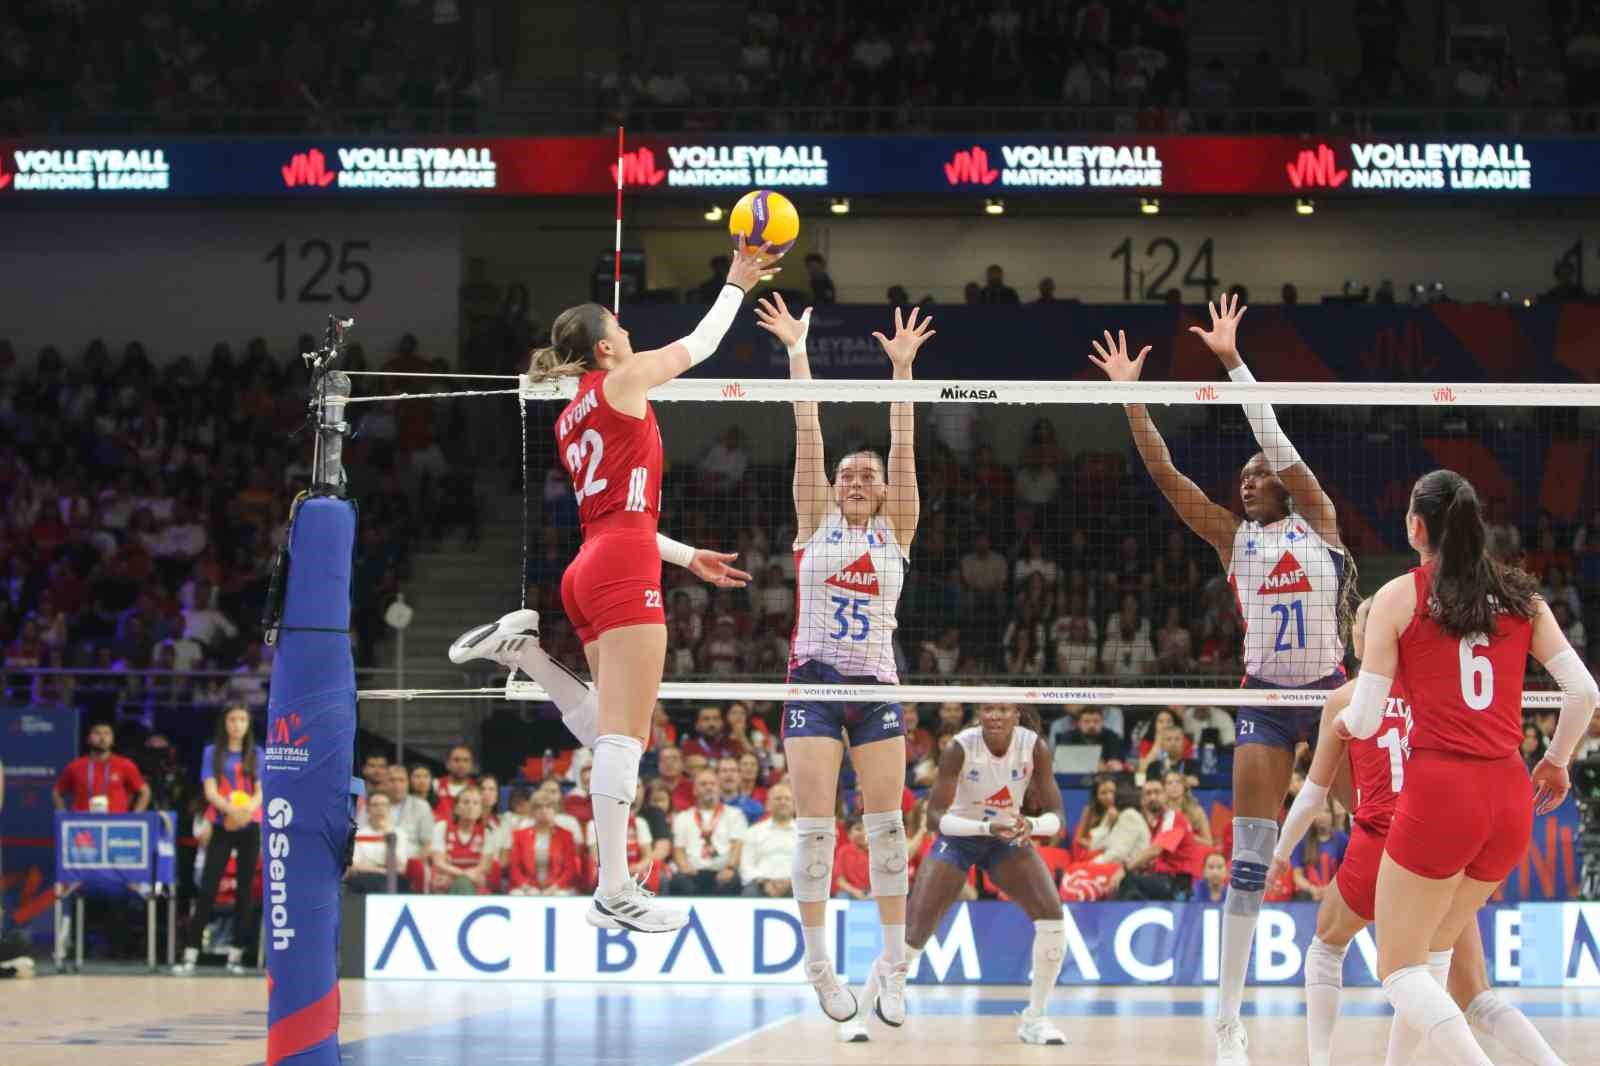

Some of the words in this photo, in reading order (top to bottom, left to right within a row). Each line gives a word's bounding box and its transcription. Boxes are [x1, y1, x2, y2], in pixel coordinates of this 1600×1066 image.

[14, 149, 169, 172] VOLLEYBALL
[338, 148, 496, 170] VOLLEYBALL
[667, 146, 828, 168] VOLLEYBALL
[1001, 146, 1162, 168] VOLLEYBALL
[1351, 144, 1531, 168] VOLLEYBALL
[14, 172, 94, 190] NATIONS
[98, 172, 169, 190] LEAGUE
[338, 170, 421, 188] NATIONS
[424, 170, 496, 188] LEAGUE
[667, 168, 750, 186] NATIONS
[755, 168, 828, 186] LEAGUE
[1002, 168, 1085, 186] NATIONS
[1089, 168, 1162, 186] LEAGUE
[1352, 169, 1445, 188] NATIONS
[1451, 169, 1531, 189] LEAGUE
[264, 239, 373, 303] 125
[1110, 237, 1220, 301] 124
[566, 428, 607, 506] 22
[836, 570, 877, 587] MAIF
[1265, 569, 1305, 590] MAIF
[645, 590, 661, 608] 22
[830, 596, 870, 641] 35
[1271, 599, 1306, 653] 21
[1459, 631, 1494, 711] 6
[1042, 691, 1096, 699] VOLLEYBALL
[1523, 695, 1562, 703] VOLLEYB
[789, 710, 806, 728] 35
[1240, 719, 1255, 735] 21
[268, 831, 296, 951] senoh
